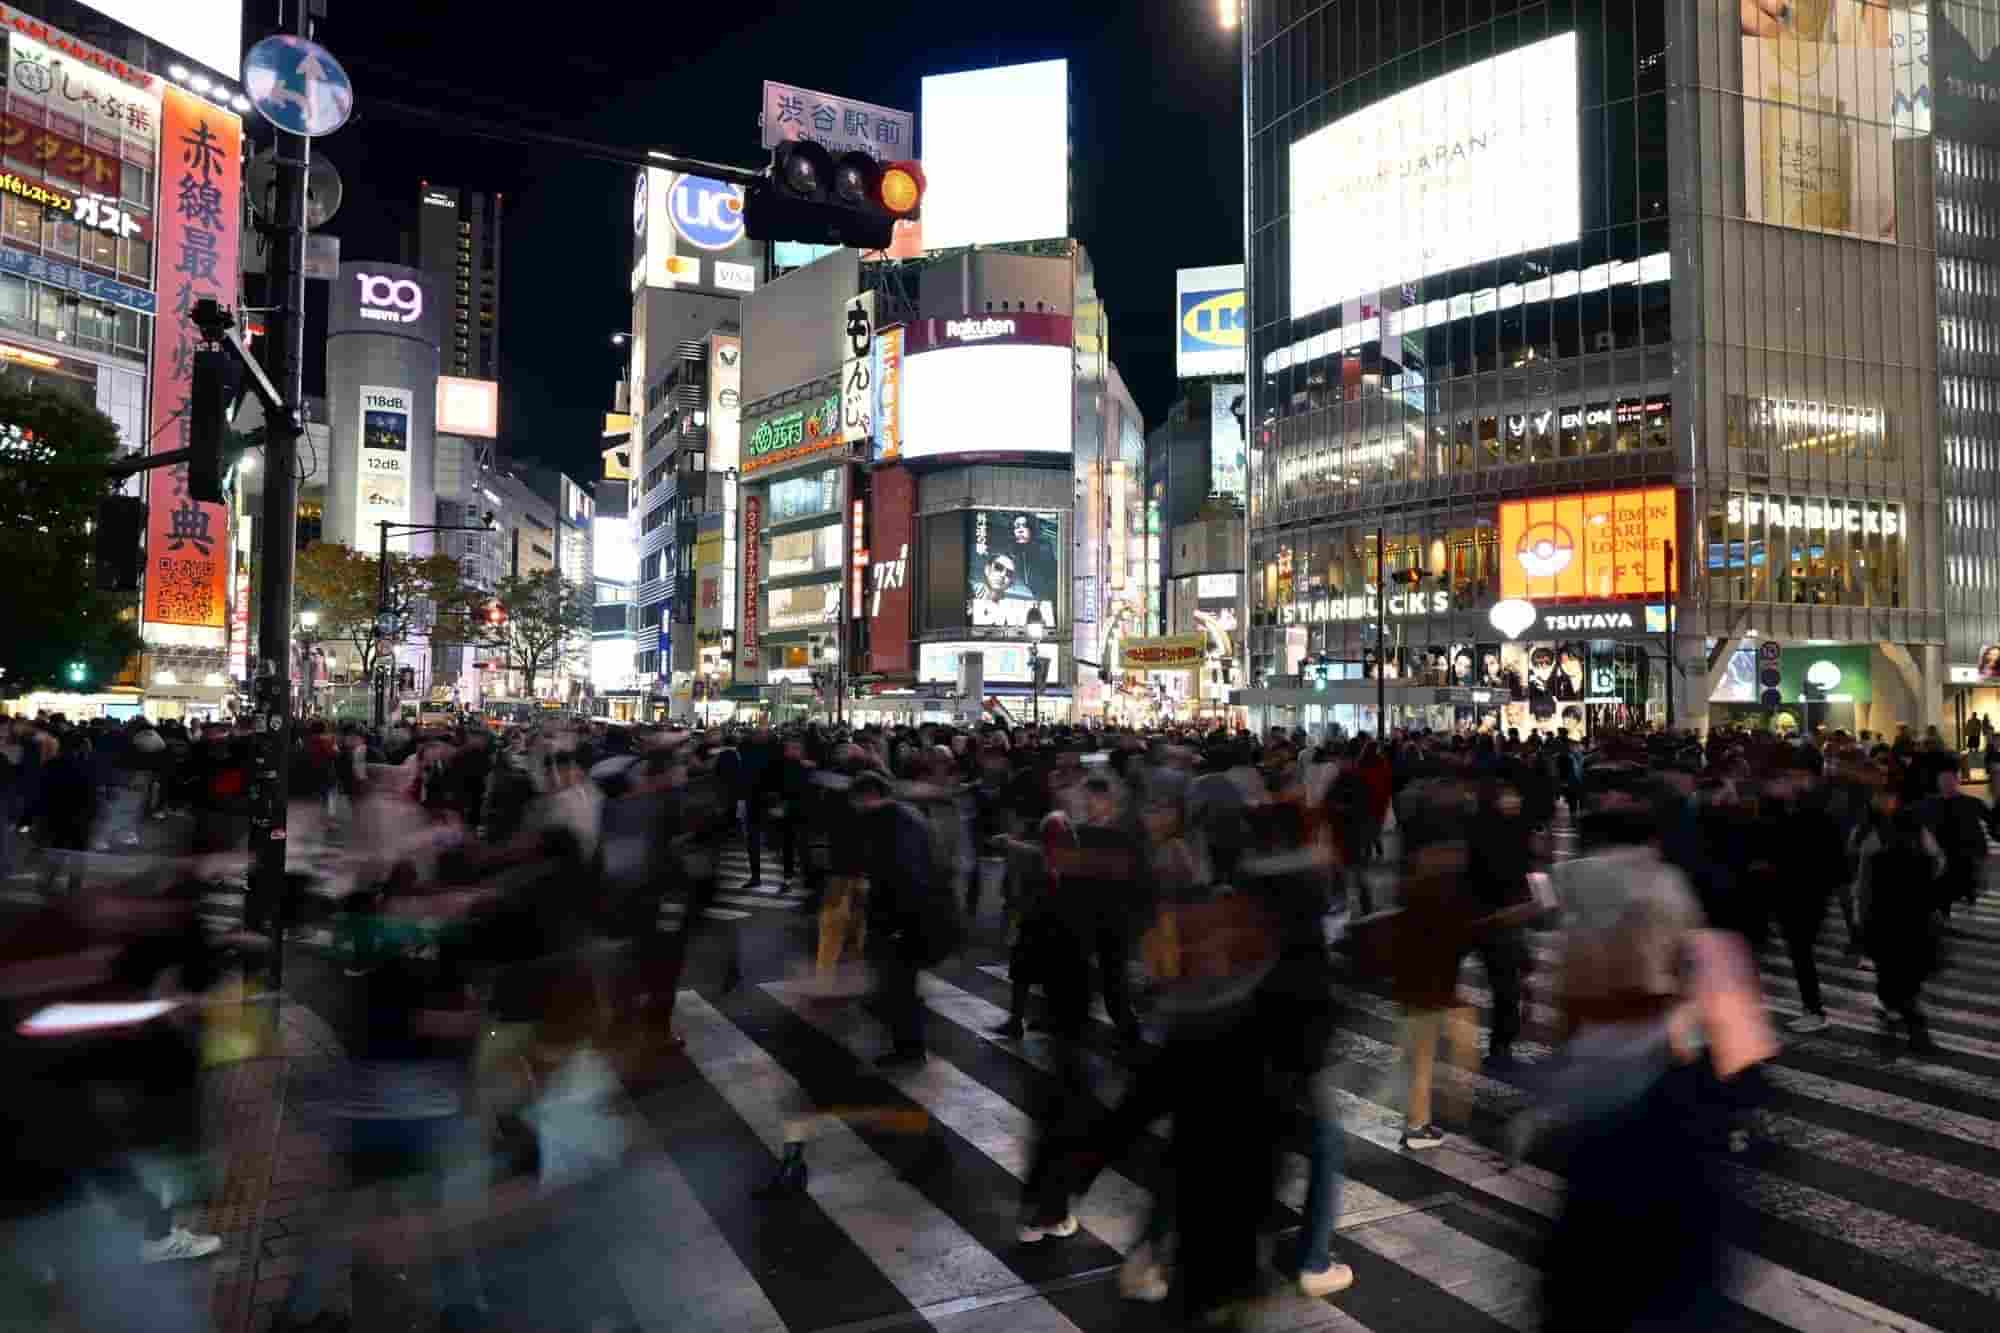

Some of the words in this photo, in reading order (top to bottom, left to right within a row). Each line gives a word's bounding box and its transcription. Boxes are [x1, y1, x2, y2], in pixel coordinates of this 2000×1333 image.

[776, 95, 902, 144] 渋谷駅前
[74, 195, 142, 238] ガスト
[356, 272, 422, 322] 109
[946, 318, 1016, 337] Rakuten
[1727, 498, 1897, 535] STARBUCKS
[1544, 612, 1633, 631] TSUTAYA
